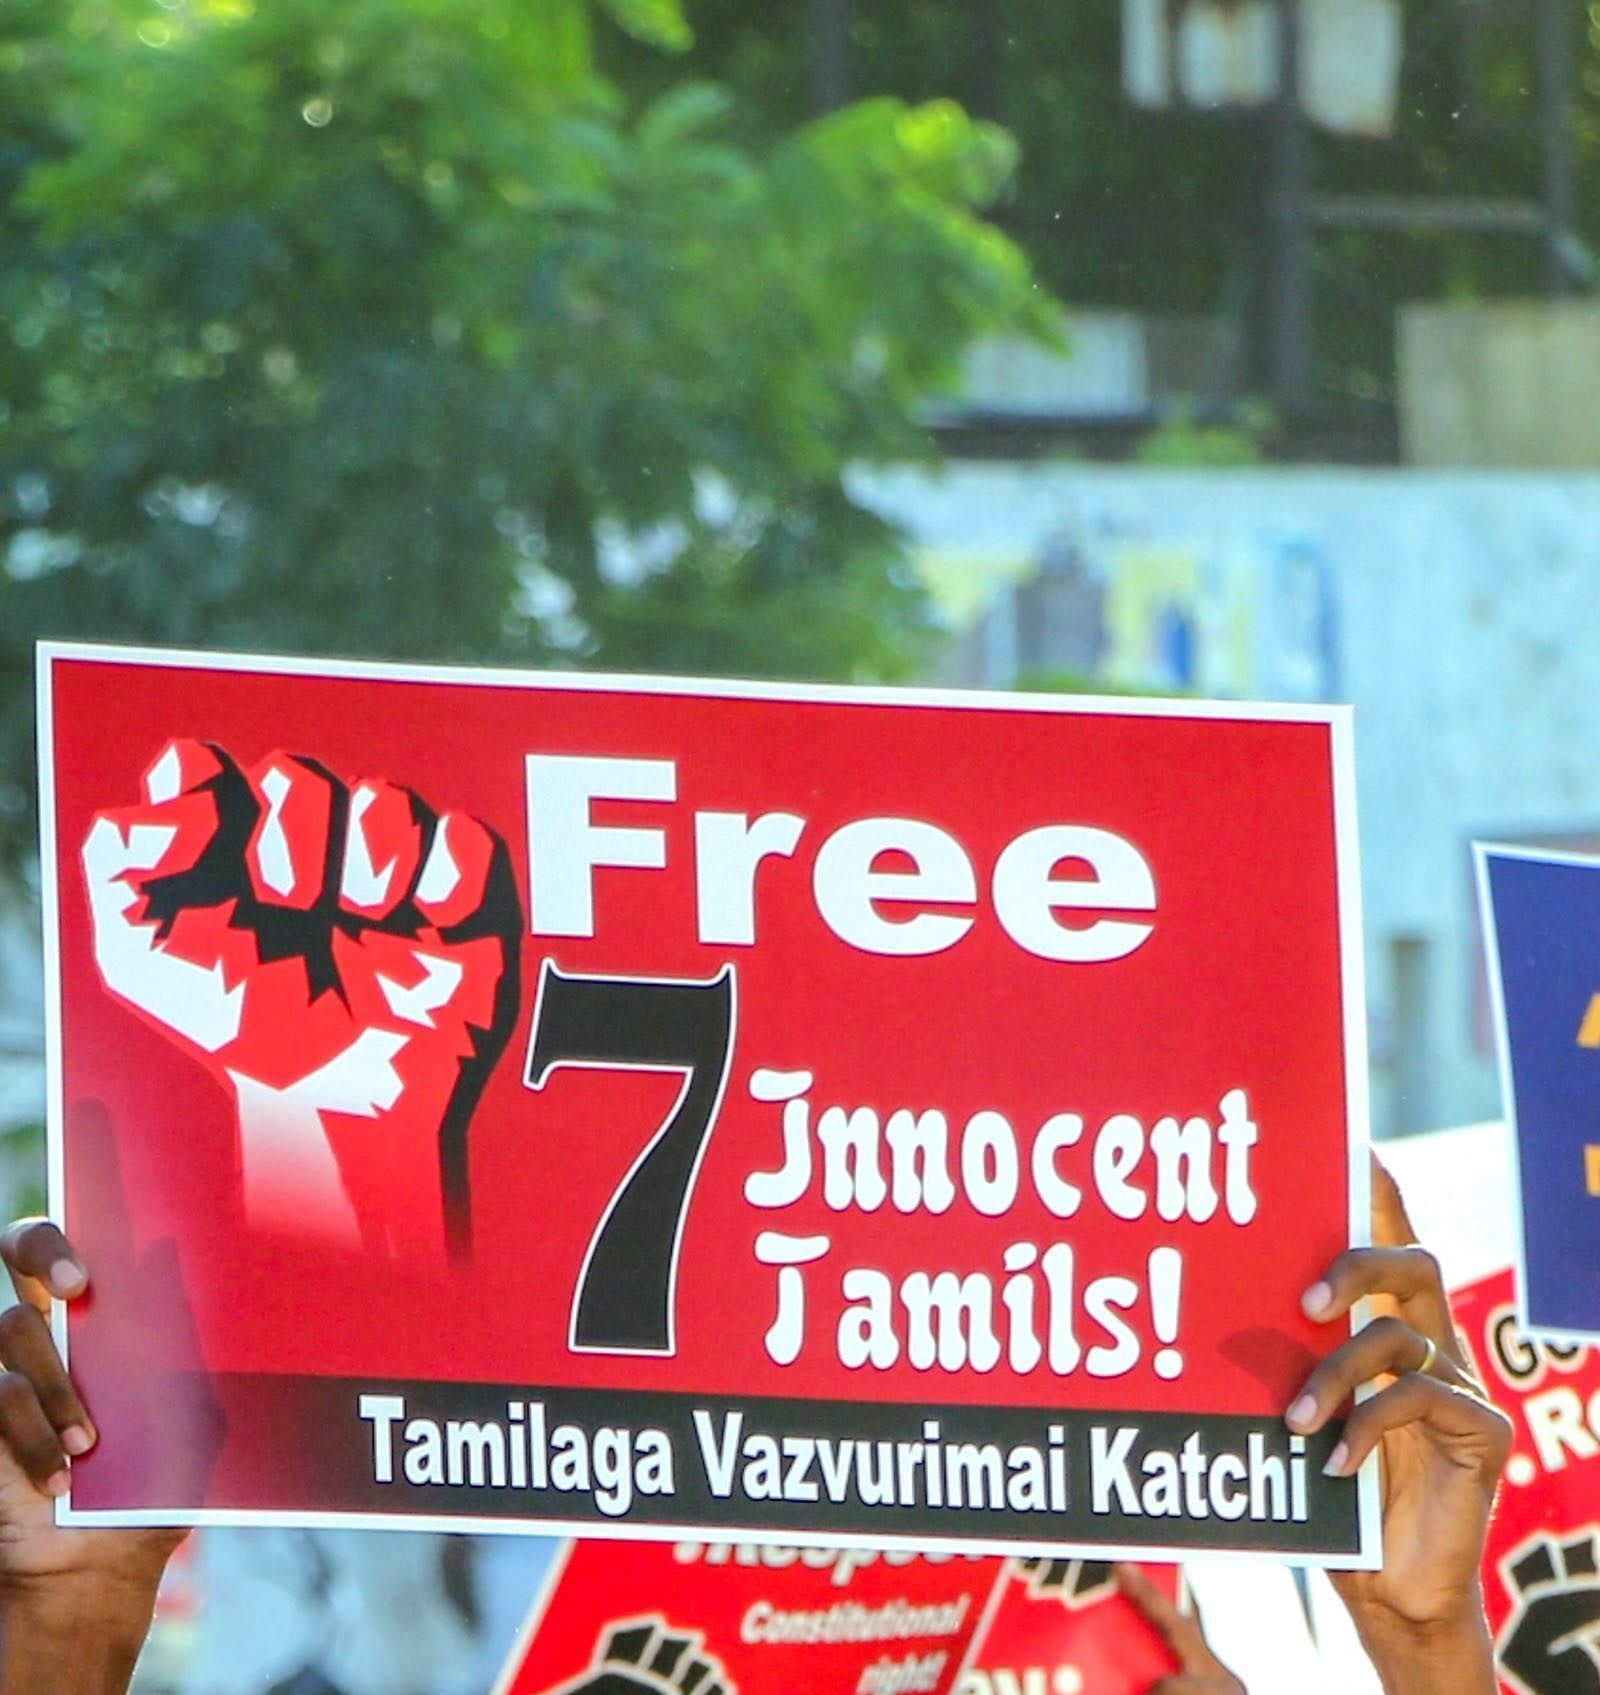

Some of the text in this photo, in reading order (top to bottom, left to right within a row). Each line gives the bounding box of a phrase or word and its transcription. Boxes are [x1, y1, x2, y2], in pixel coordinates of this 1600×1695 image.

[527, 755, 1158, 963] Free
[522, 959, 737, 1359] 7
[744, 1070, 1257, 1227] Innocent
[756, 1231, 1185, 1381] Tamils!
[359, 1394, 1309, 1524] Tamilaga Vazvurimai Katchi
[741, 1592, 972, 1645] Constitutional
